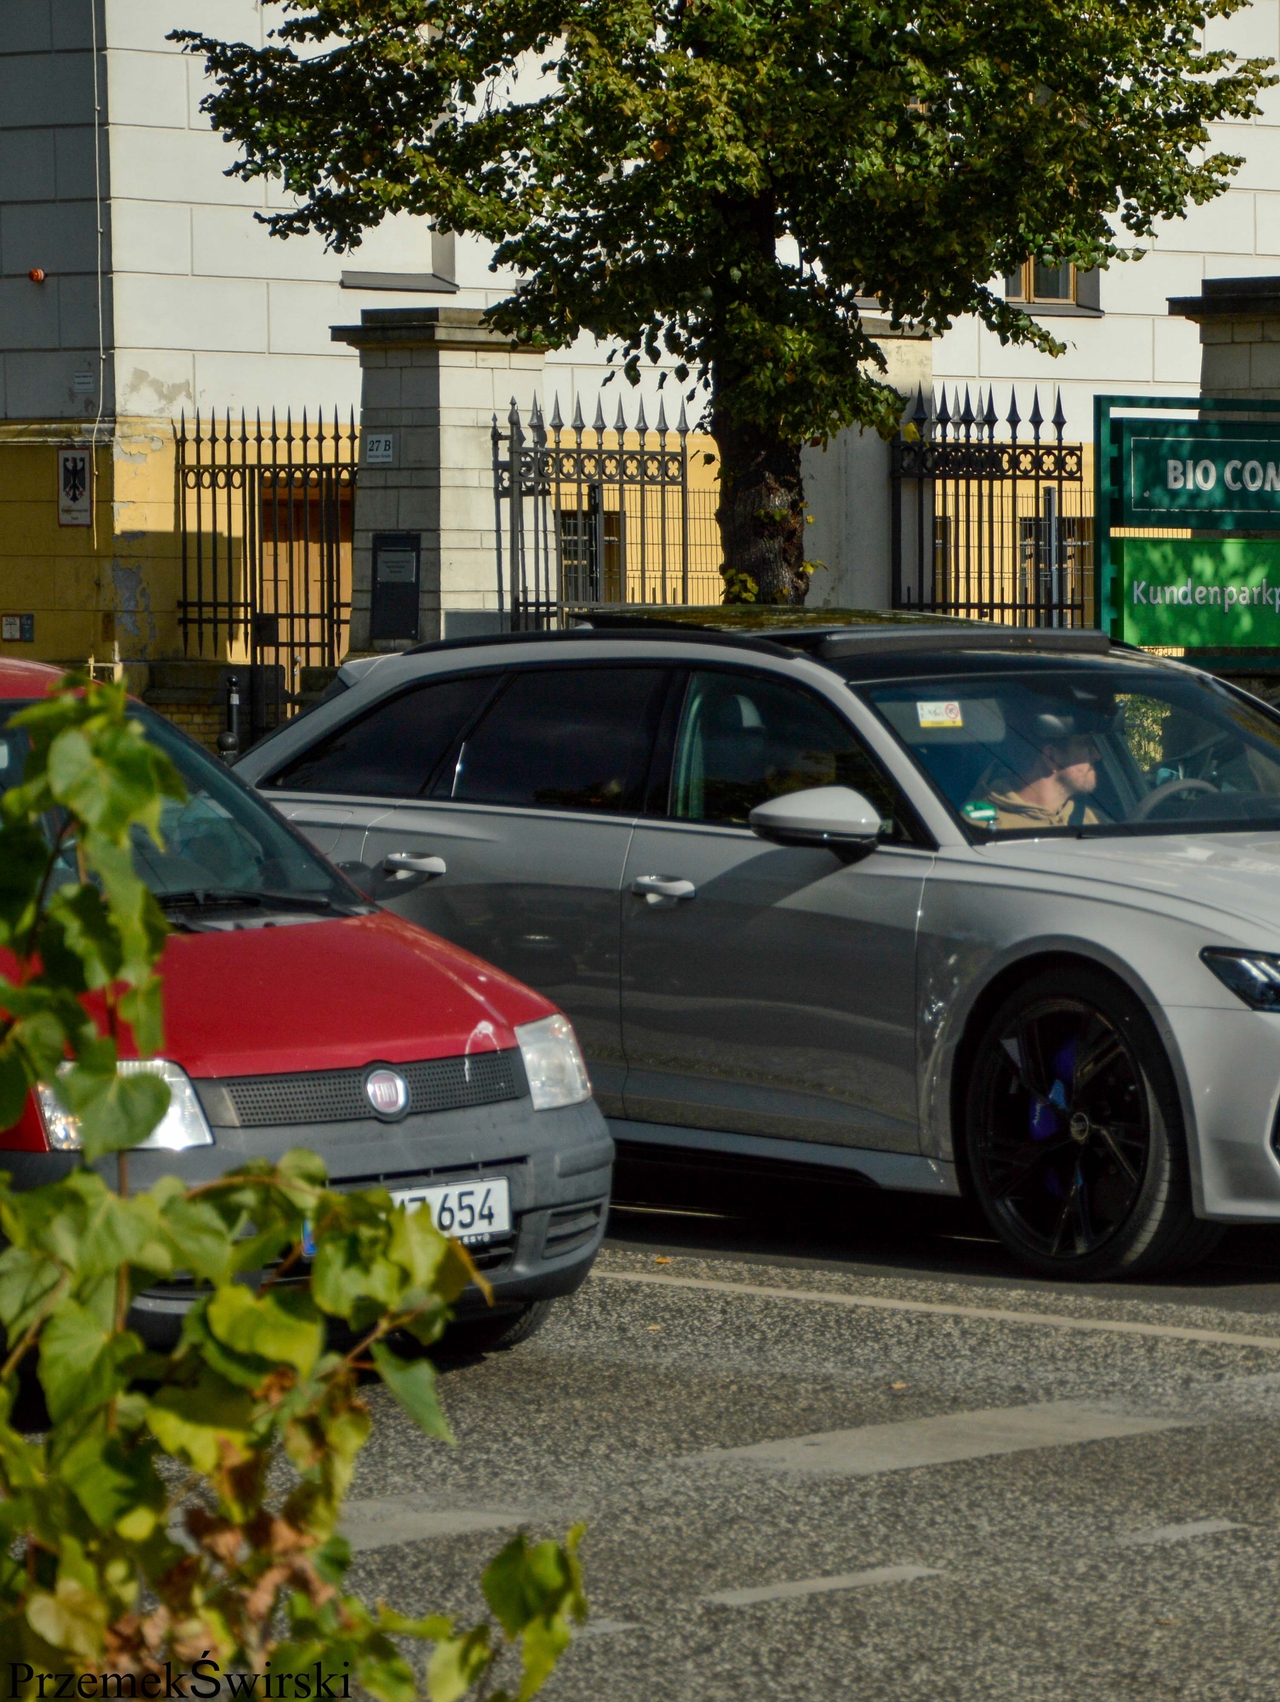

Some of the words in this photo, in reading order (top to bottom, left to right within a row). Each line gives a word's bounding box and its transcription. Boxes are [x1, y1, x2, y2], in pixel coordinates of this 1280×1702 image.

[368, 440, 381, 452] 27
[383, 440, 391, 452] B
[1167, 459, 1217, 491] BIO
